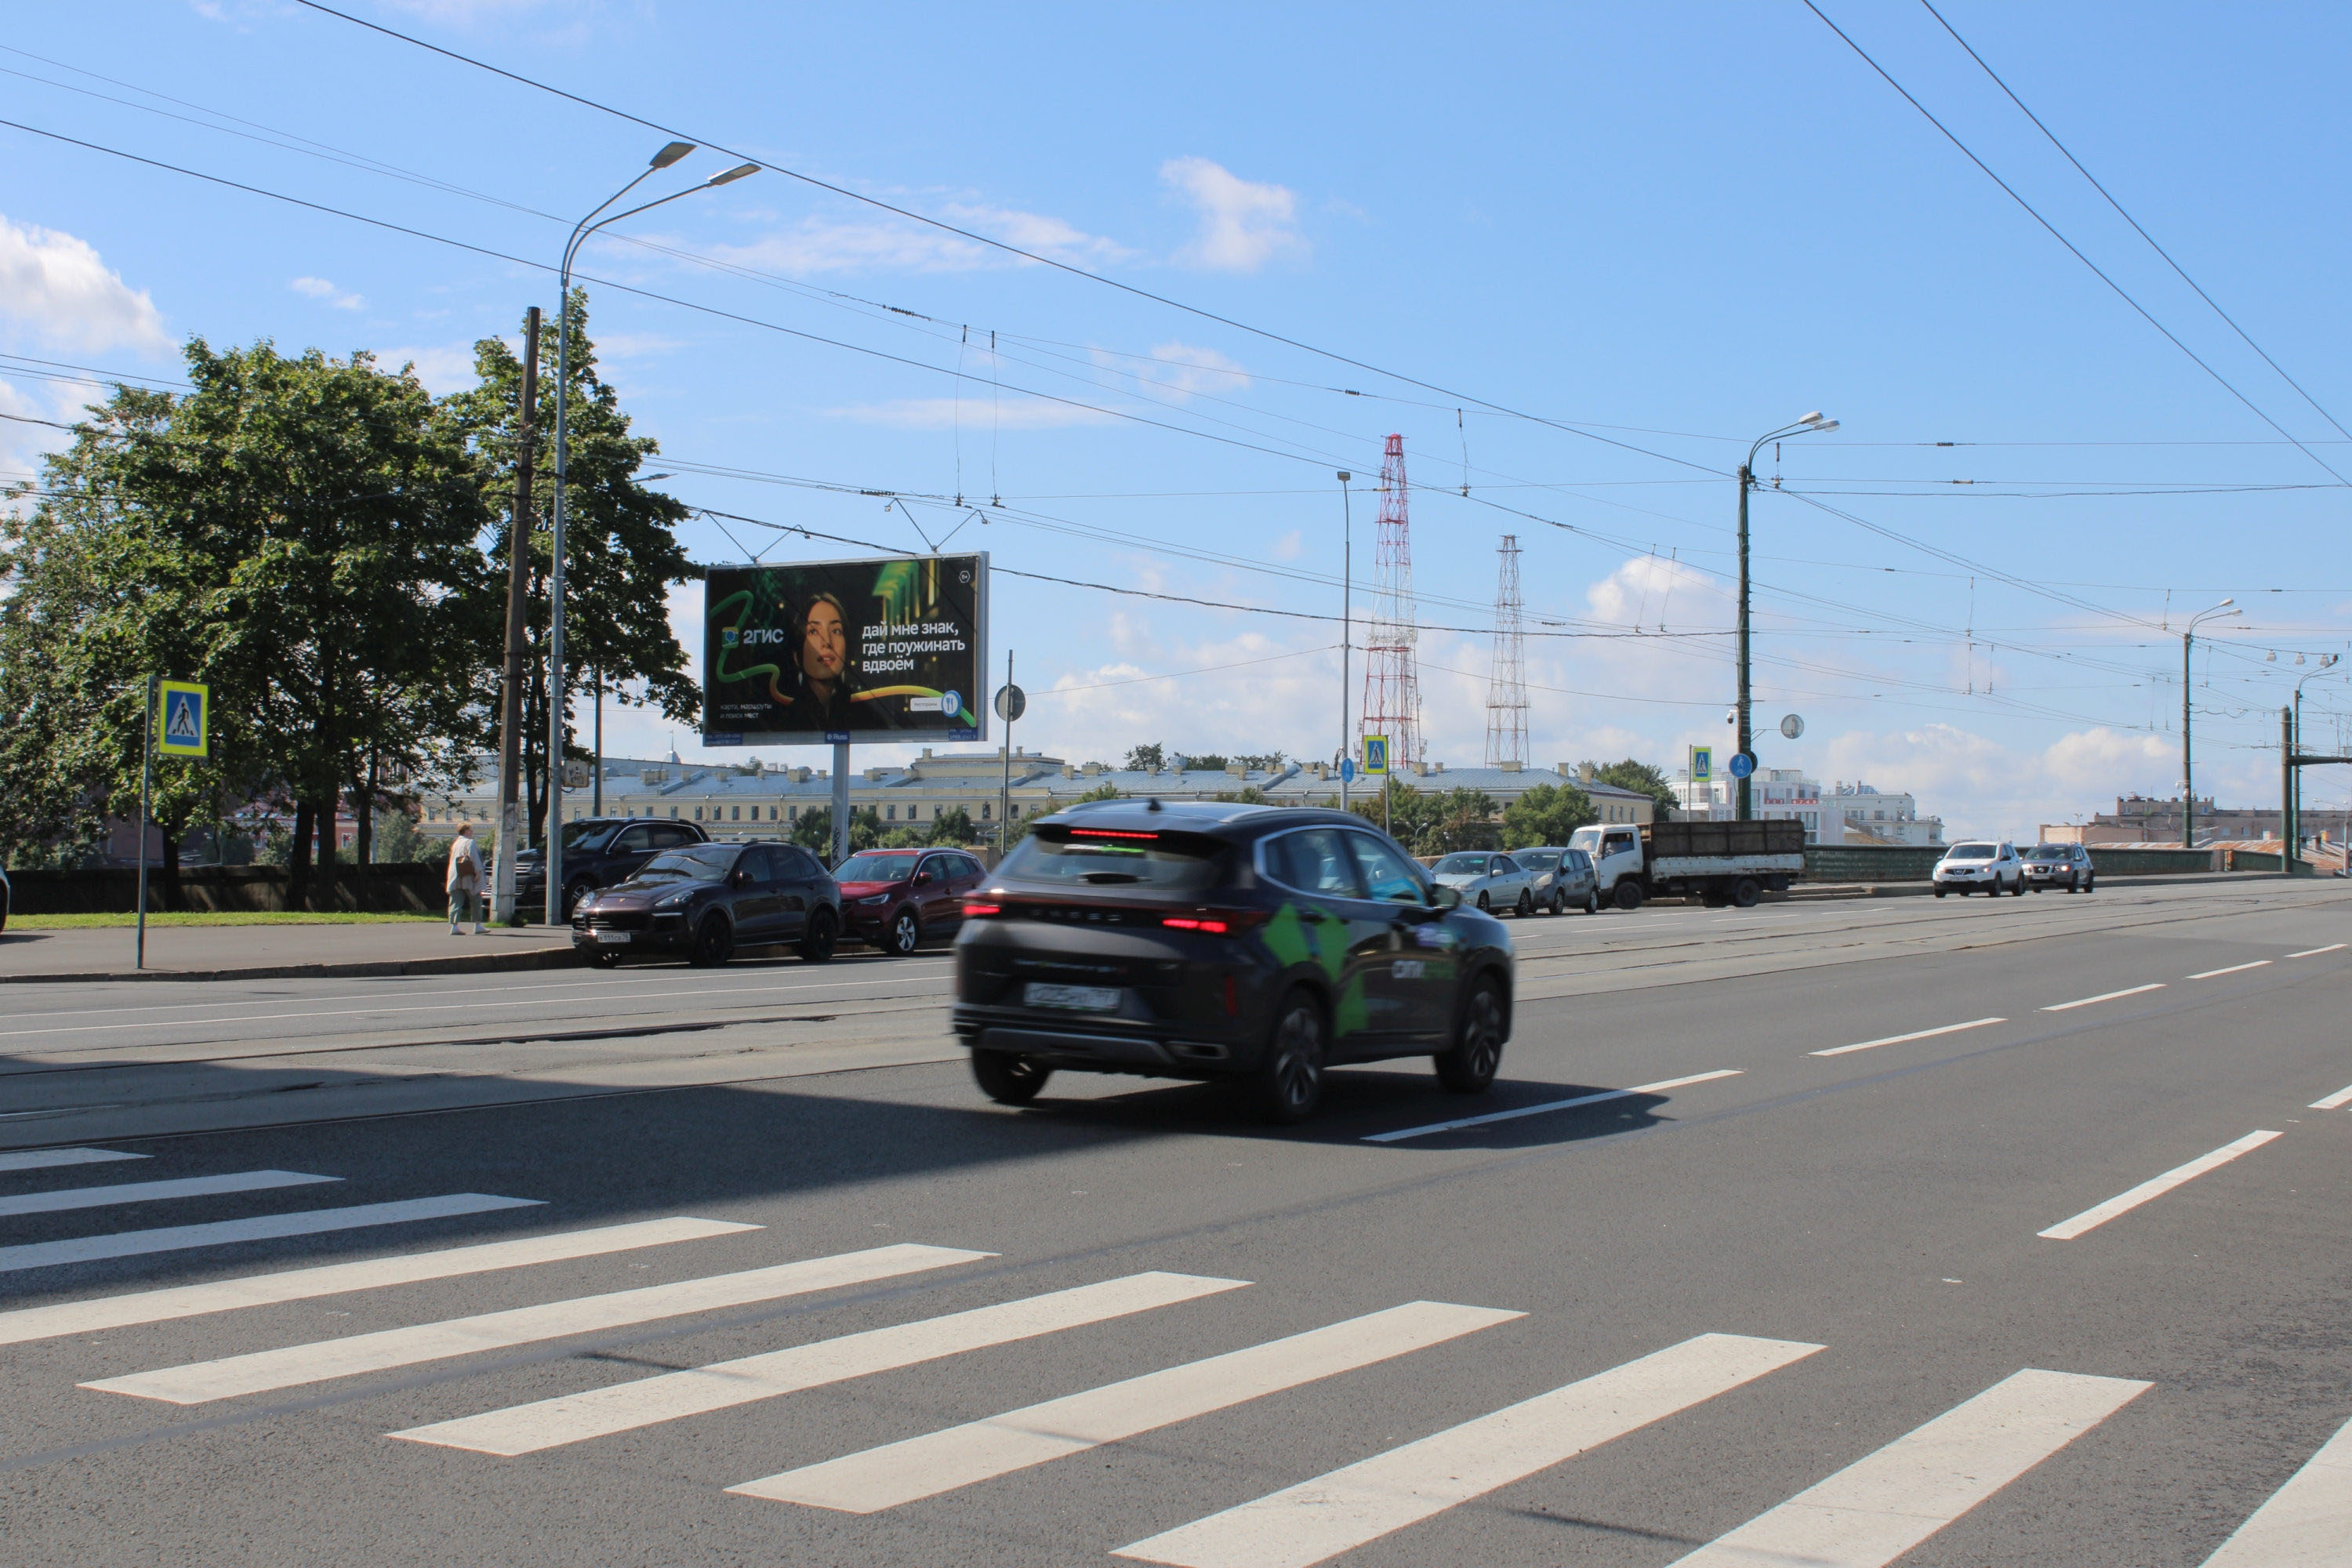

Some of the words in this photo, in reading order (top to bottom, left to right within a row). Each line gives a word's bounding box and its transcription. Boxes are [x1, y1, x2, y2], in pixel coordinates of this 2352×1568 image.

[743, 629, 784, 644] 2ГИС
[862, 620, 887, 639] дай
[891, 624, 919, 636] мне
[921, 622, 958, 636] знак,
[862, 643, 886, 656] где
[888, 640, 966, 656] поужинать
[862, 655, 914, 673] вдвоём
